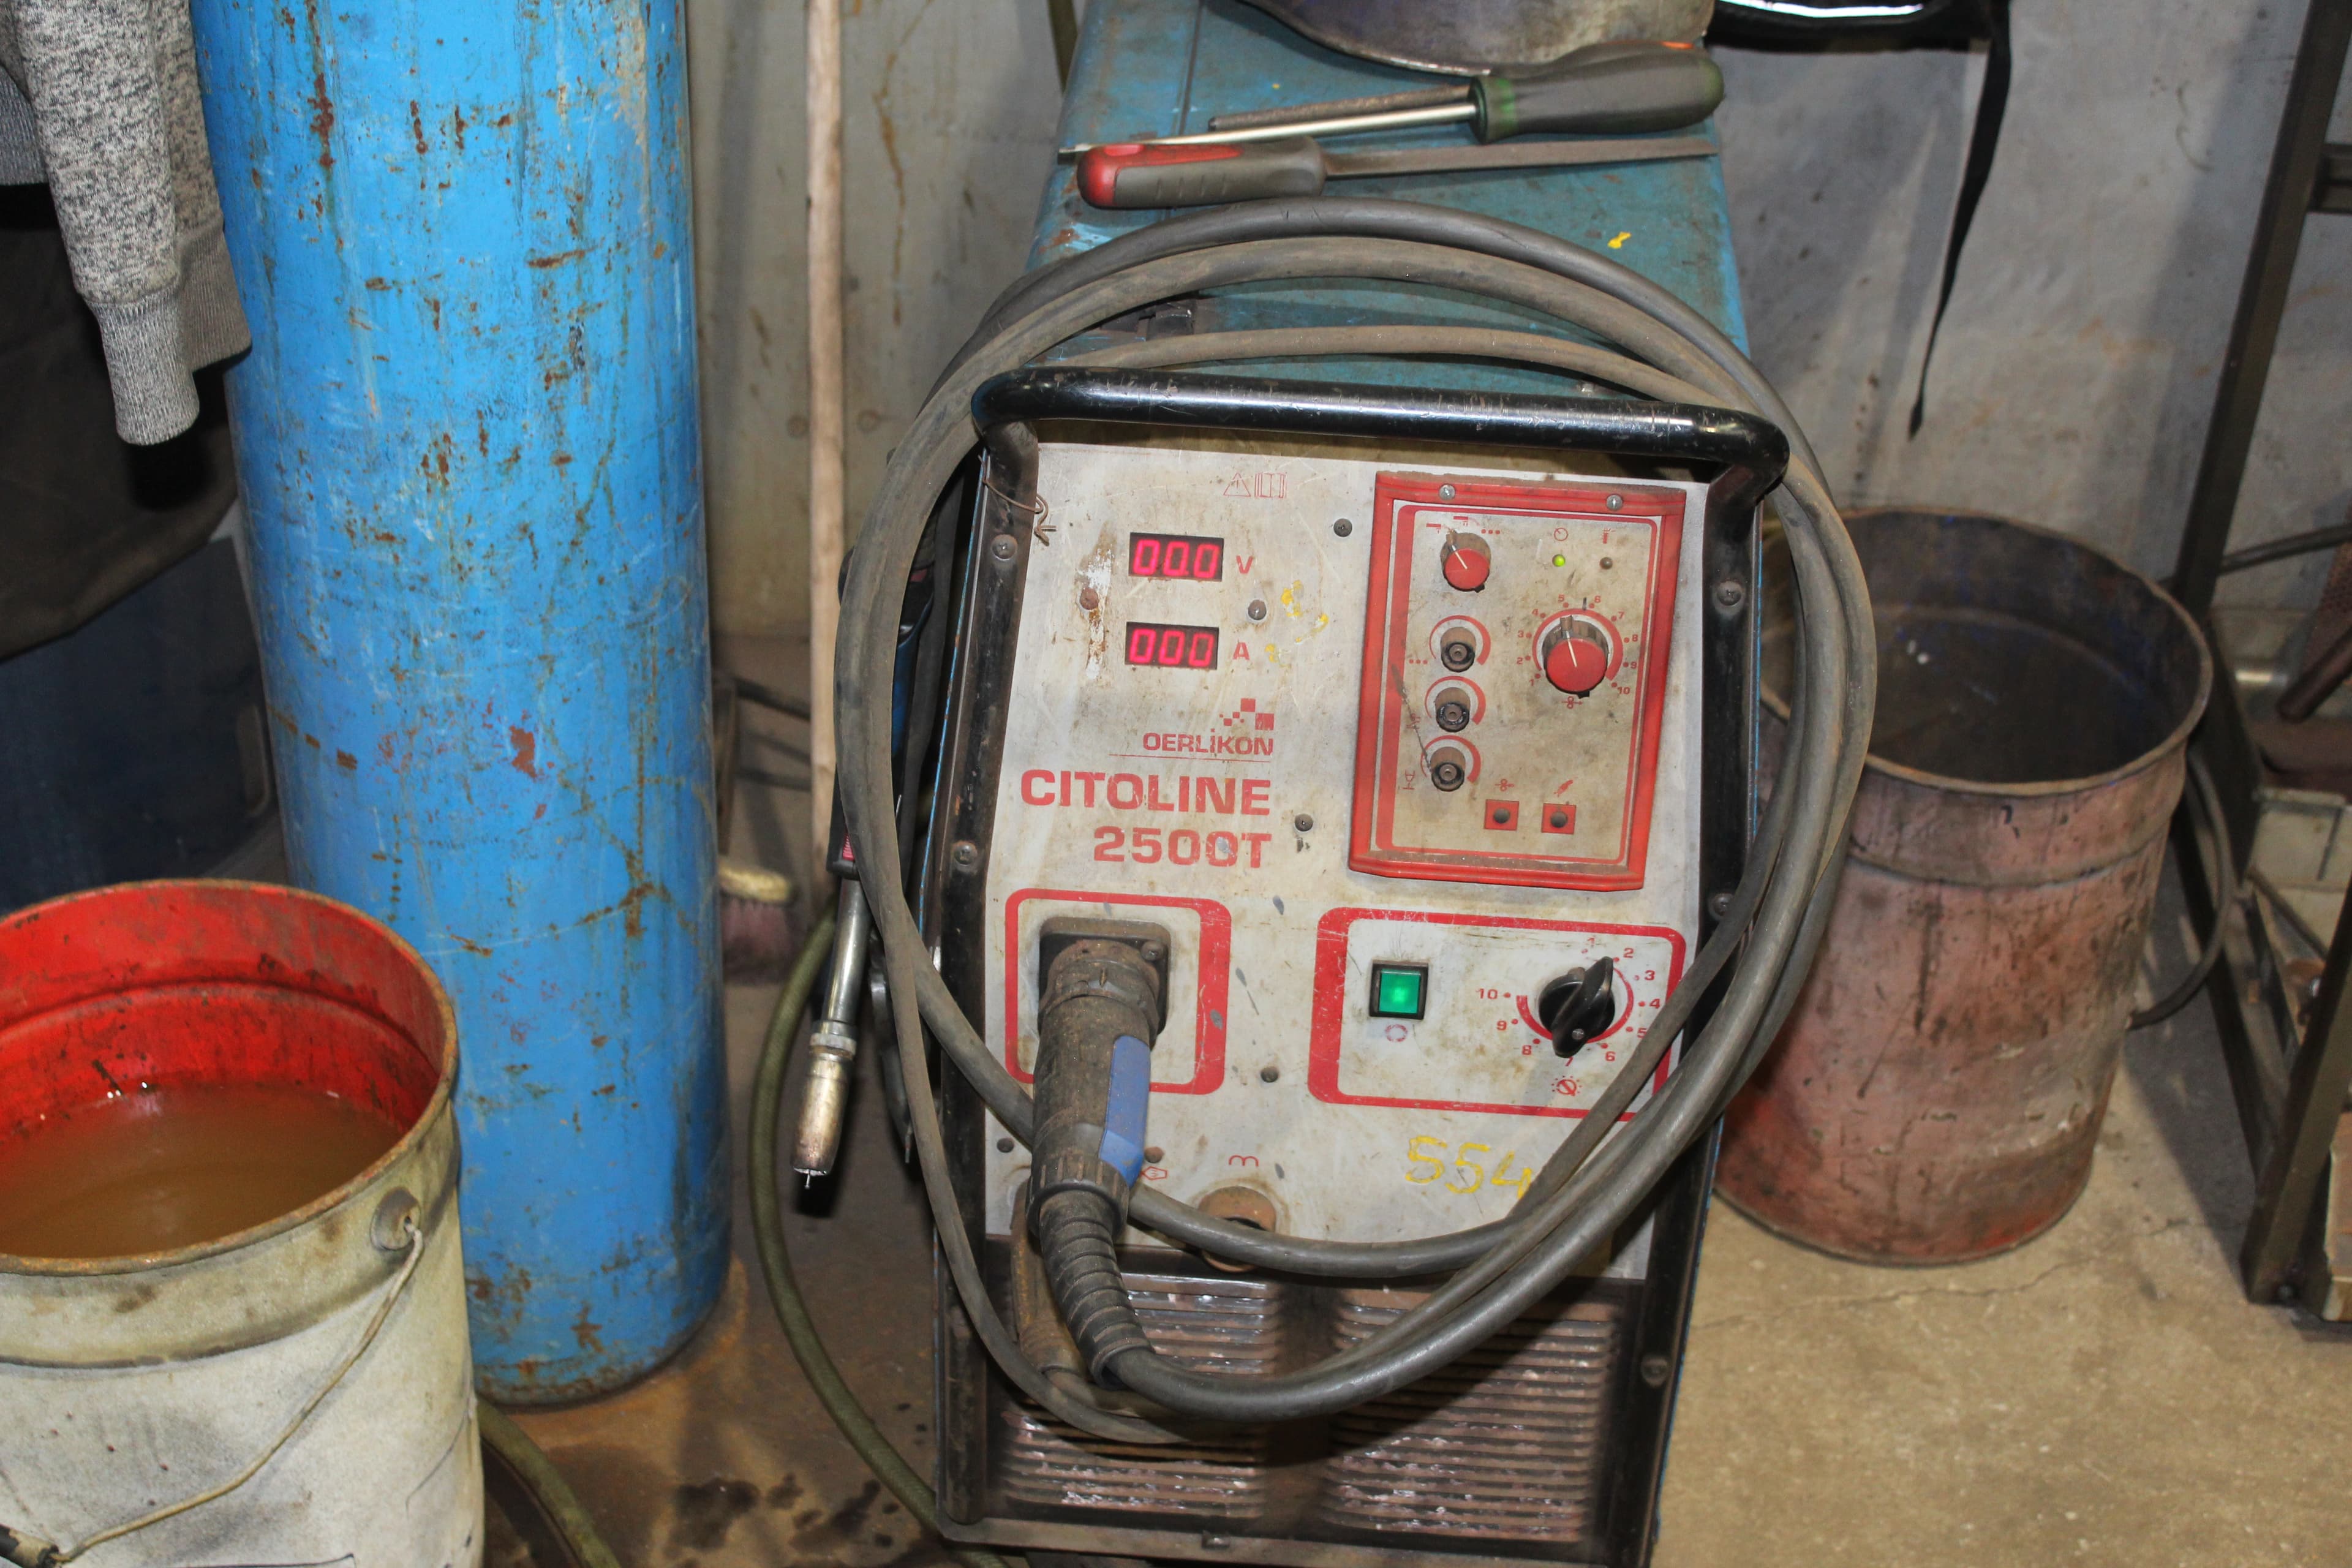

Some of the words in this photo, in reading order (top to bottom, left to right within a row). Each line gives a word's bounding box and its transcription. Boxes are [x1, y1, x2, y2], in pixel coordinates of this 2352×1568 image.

[1236, 556, 1253, 574] V
[1129, 628, 1214, 668] 000
[1233, 642, 1250, 660] A
[1021, 769, 1270, 815] CITOLINE
[1093, 826, 1272, 868] 2500T
[1624, 948, 1634, 958] 2
[1645, 971, 1655, 980] 3
[1477, 989, 1498, 999] 10
[1649, 999, 1660, 1009] 4
[1497, 1020, 1507, 1030] 9
[1637, 1028, 1647, 1038] 5
[1521, 1045, 1532, 1055] 8
[1605, 1051, 1615, 1061] 6
[1405, 1136, 1532, 1200] 554
